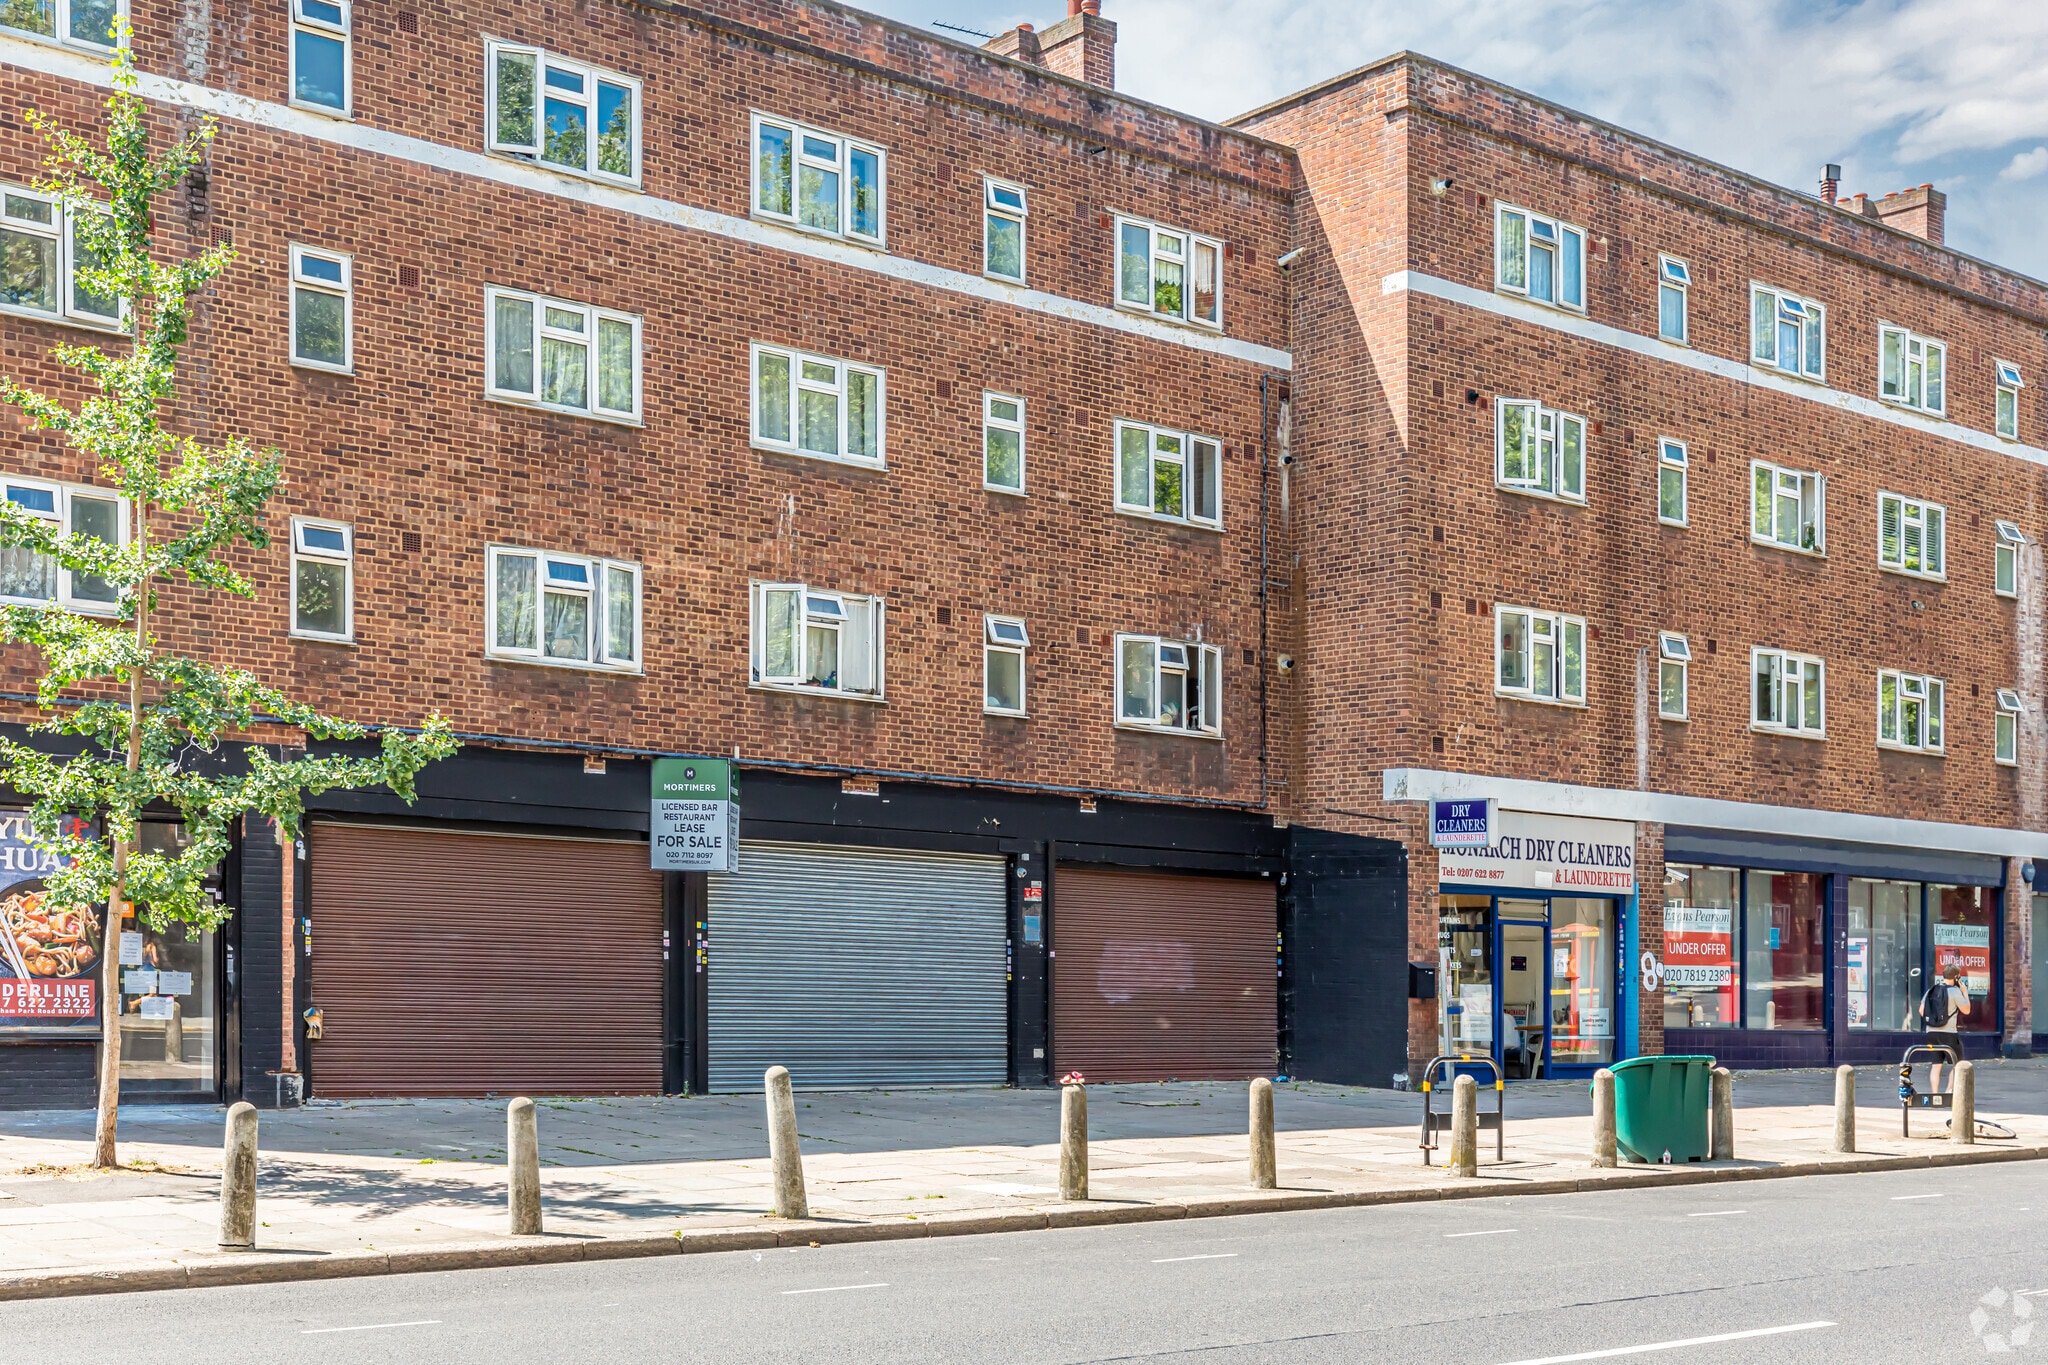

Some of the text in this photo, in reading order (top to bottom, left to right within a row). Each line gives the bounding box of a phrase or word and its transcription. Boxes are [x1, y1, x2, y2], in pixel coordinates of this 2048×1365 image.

[663, 783, 717, 792] MORTIMERS
[661, 803, 700, 811] LICENSED
[1451, 804, 1471, 817] DRY
[663, 813, 716, 821] RESTAURANT
[674, 824, 705, 833] LEASE
[1437, 818, 1486, 832] CLEANERS
[657, 835, 722, 848] FOR SALE
[1442, 833, 1486, 842] LAUNDERETTE
[0, 847, 63, 872] HUA
[1525, 838, 1555, 862] DRY
[1558, 841, 1632, 868] CLEANERS
[1441, 867, 1504, 880] Tel: 0207 622 8877
[1555, 869, 1632, 888] & LAUNDERETTE
[1694, 909, 1730, 923] Pearson
[1935, 924, 1989, 939] Evans Pearson
[1668, 942, 1727, 955] UNDER OFFER
[1939, 954, 1986, 967] UNDER OFFER
[1664, 968, 1730, 982] 020 7819 2380
[2, 983, 90, 998] DERLINE
[2, 997, 91, 1009] 7 622 2322
